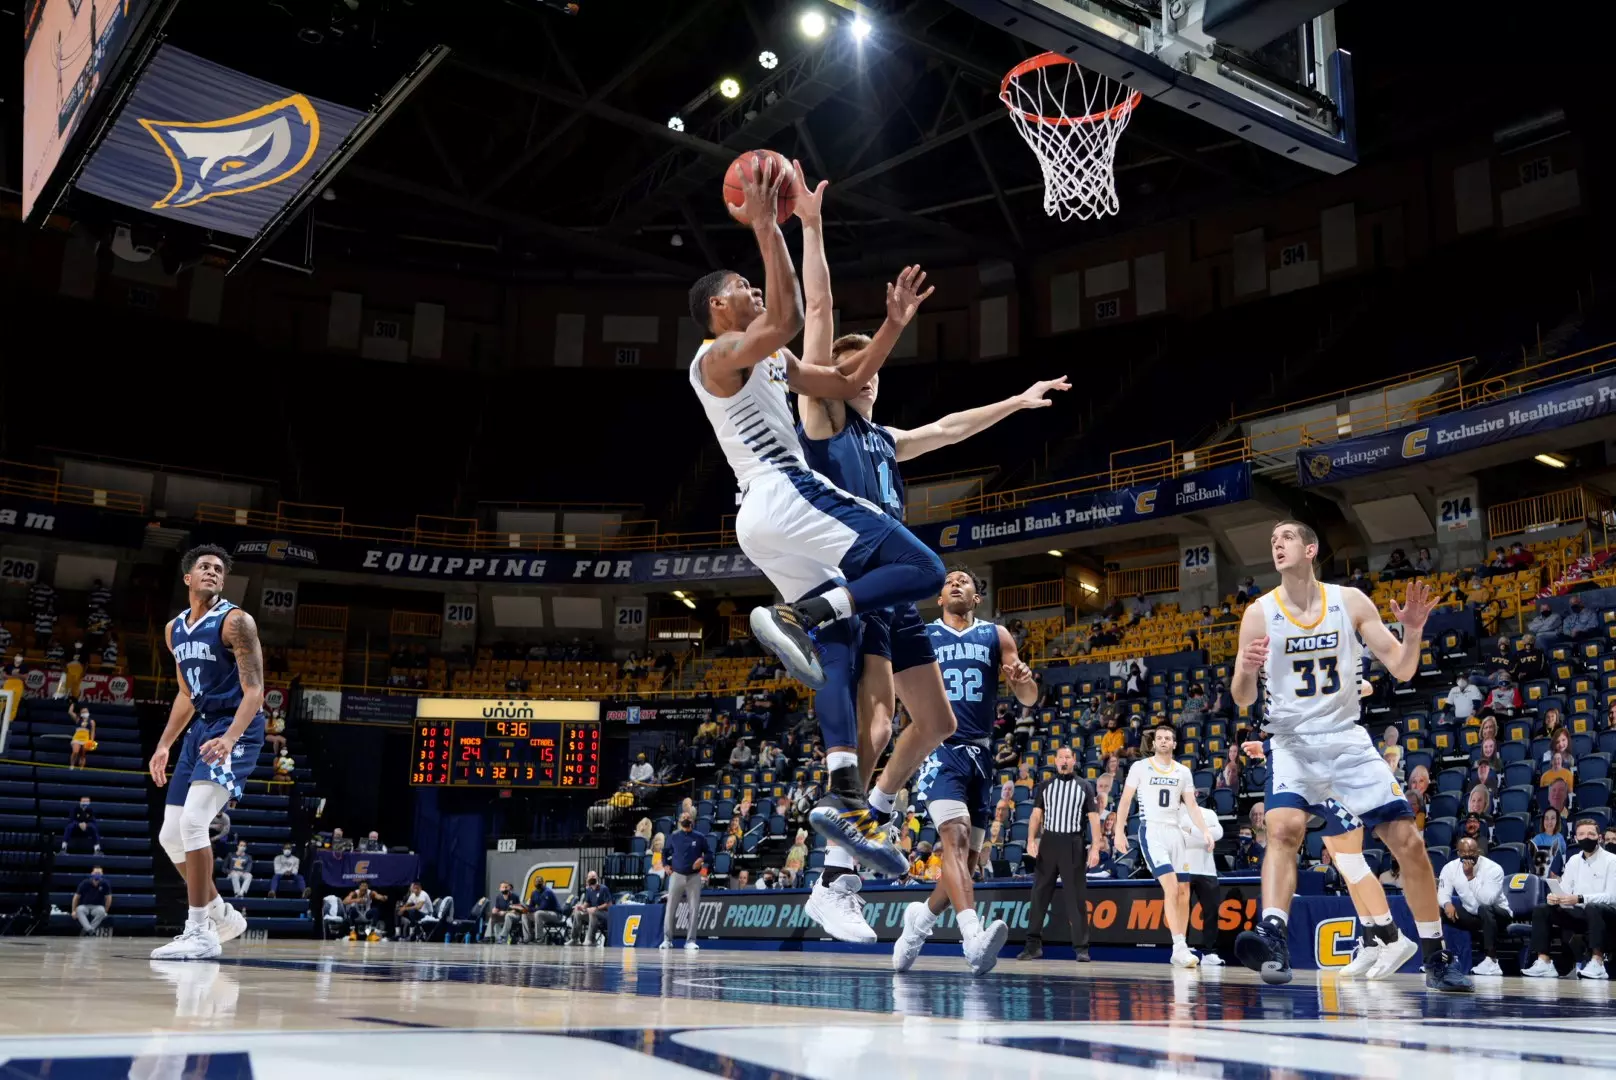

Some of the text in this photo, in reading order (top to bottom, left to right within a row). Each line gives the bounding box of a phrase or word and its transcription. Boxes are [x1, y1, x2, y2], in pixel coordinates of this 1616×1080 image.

[1523, 160, 1548, 183] 315
[1283, 244, 1304, 265] 314
[1097, 301, 1117, 317] 313
[376, 322, 397, 338] 310
[618, 350, 635, 364] 311
[1332, 445, 1390, 468] erlanger
[1436, 417, 1505, 445] Exclusive
[1508, 394, 1594, 426] Healthcare
[970, 520, 1021, 540] Official
[1024, 511, 1062, 532] Bank
[1065, 505, 1124, 525] Partner
[1175, 484, 1226, 506] FirstBank
[1441, 497, 1473, 522] 214
[236, 543, 268, 554] MOCS
[287, 546, 315, 561] CLUB
[1185, 546, 1210, 568] 213
[2, 560, 36, 580] 208
[362, 550, 547, 578] EQUIPPING
[572, 560, 633, 579] FOR
[264, 590, 293, 608] 209
[448, 605, 473, 622] 210
[618, 609, 642, 625] 210
[1286, 632, 1338, 653] MOCS
[186, 666, 203, 700] 11
[943, 667, 984, 702] 32
[1293, 656, 1341, 698] 33
[606, 710, 627, 721] FOOD
[640, 709, 658, 720] CITY
[497, 722, 528, 737] 9:36
[460, 737, 482, 746] MOCS
[529, 738, 555, 747] CITADEL
[462, 746, 553, 762] 24 1 15
[476, 767, 484, 778] 4
[492, 767, 507, 779] 32
[526, 767, 534, 780] 3
[545, 768, 553, 779] 4
[1150, 778, 1178, 786] MOCS
[1159, 788, 1170, 808] 0
[723, 904, 776, 928] PROUD
[863, 902, 886, 928] OF
